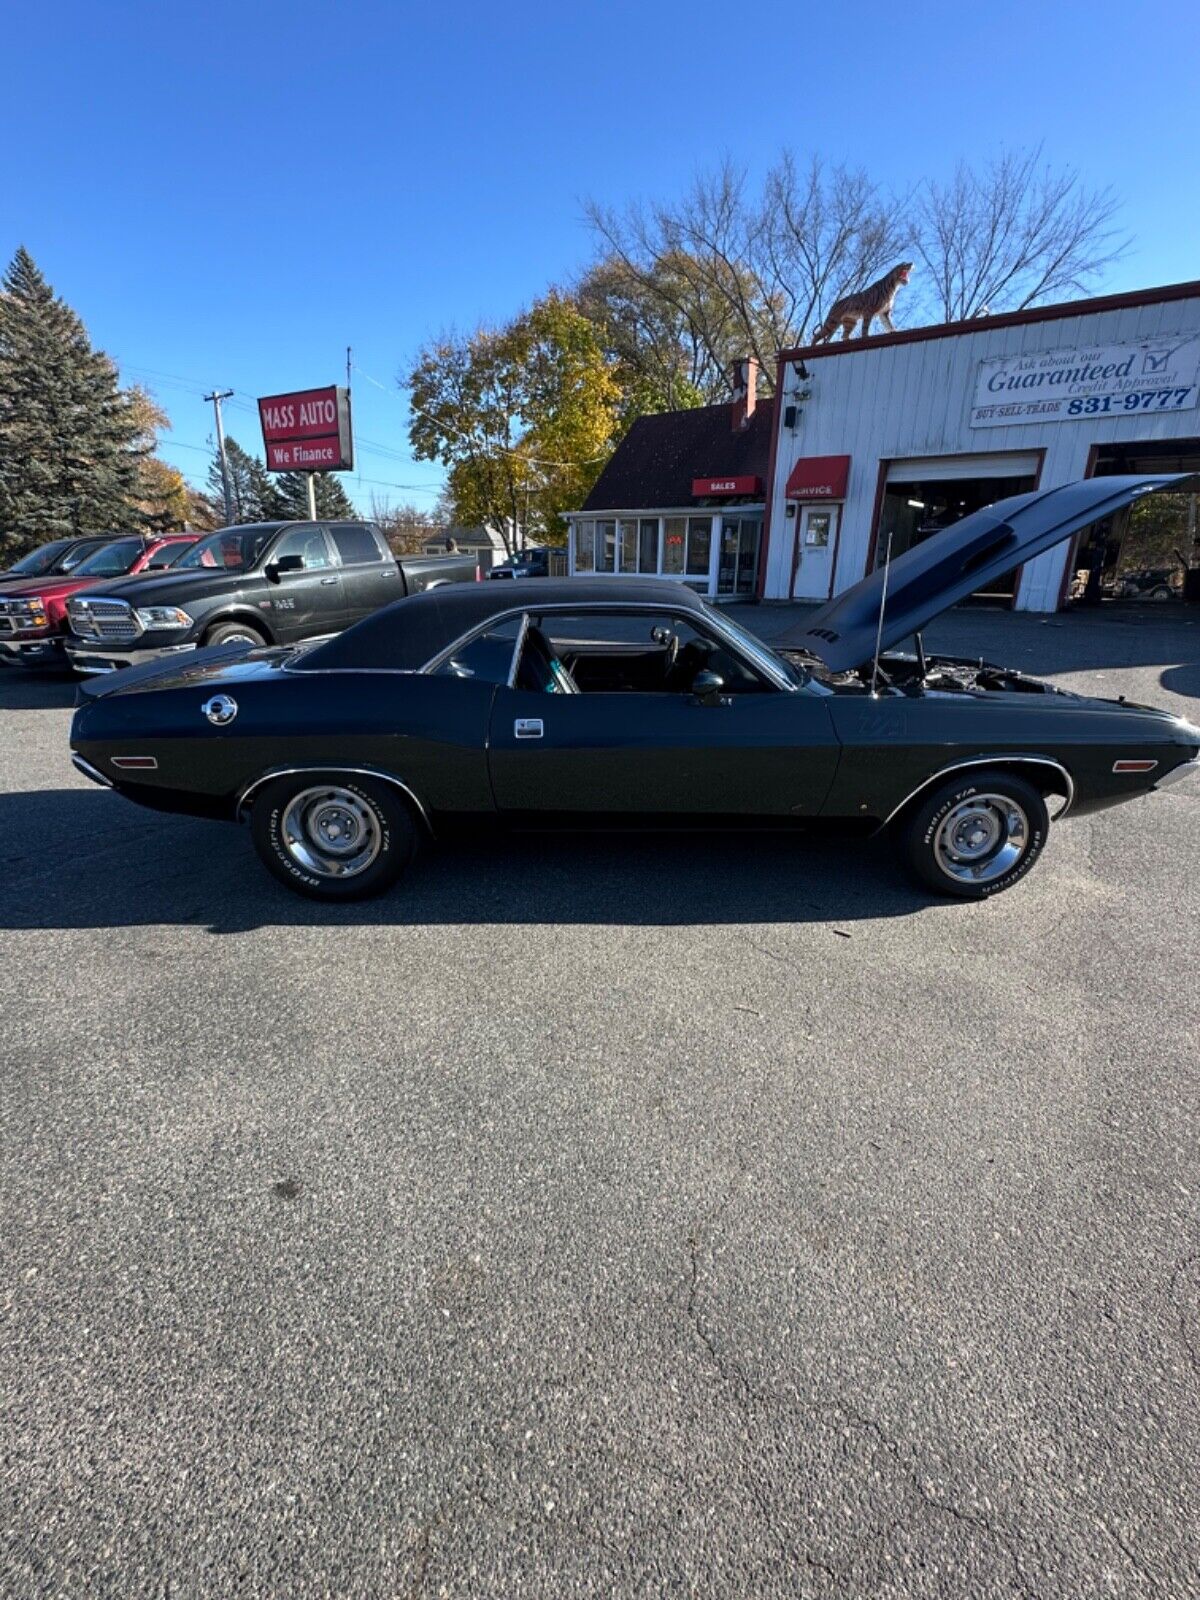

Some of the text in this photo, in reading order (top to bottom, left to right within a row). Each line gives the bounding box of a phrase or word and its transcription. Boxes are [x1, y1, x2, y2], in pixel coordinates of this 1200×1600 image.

[1014, 352, 1104, 371] Ask about our
[987, 354, 1136, 393] Guaranteed
[1068, 380, 1109, 394] Credit
[1067, 388, 1192, 415] 831-9777
[263, 399, 336, 430] MASS AUTO
[273, 446, 334, 464] We Finance
[710, 481, 736, 491] SALES
